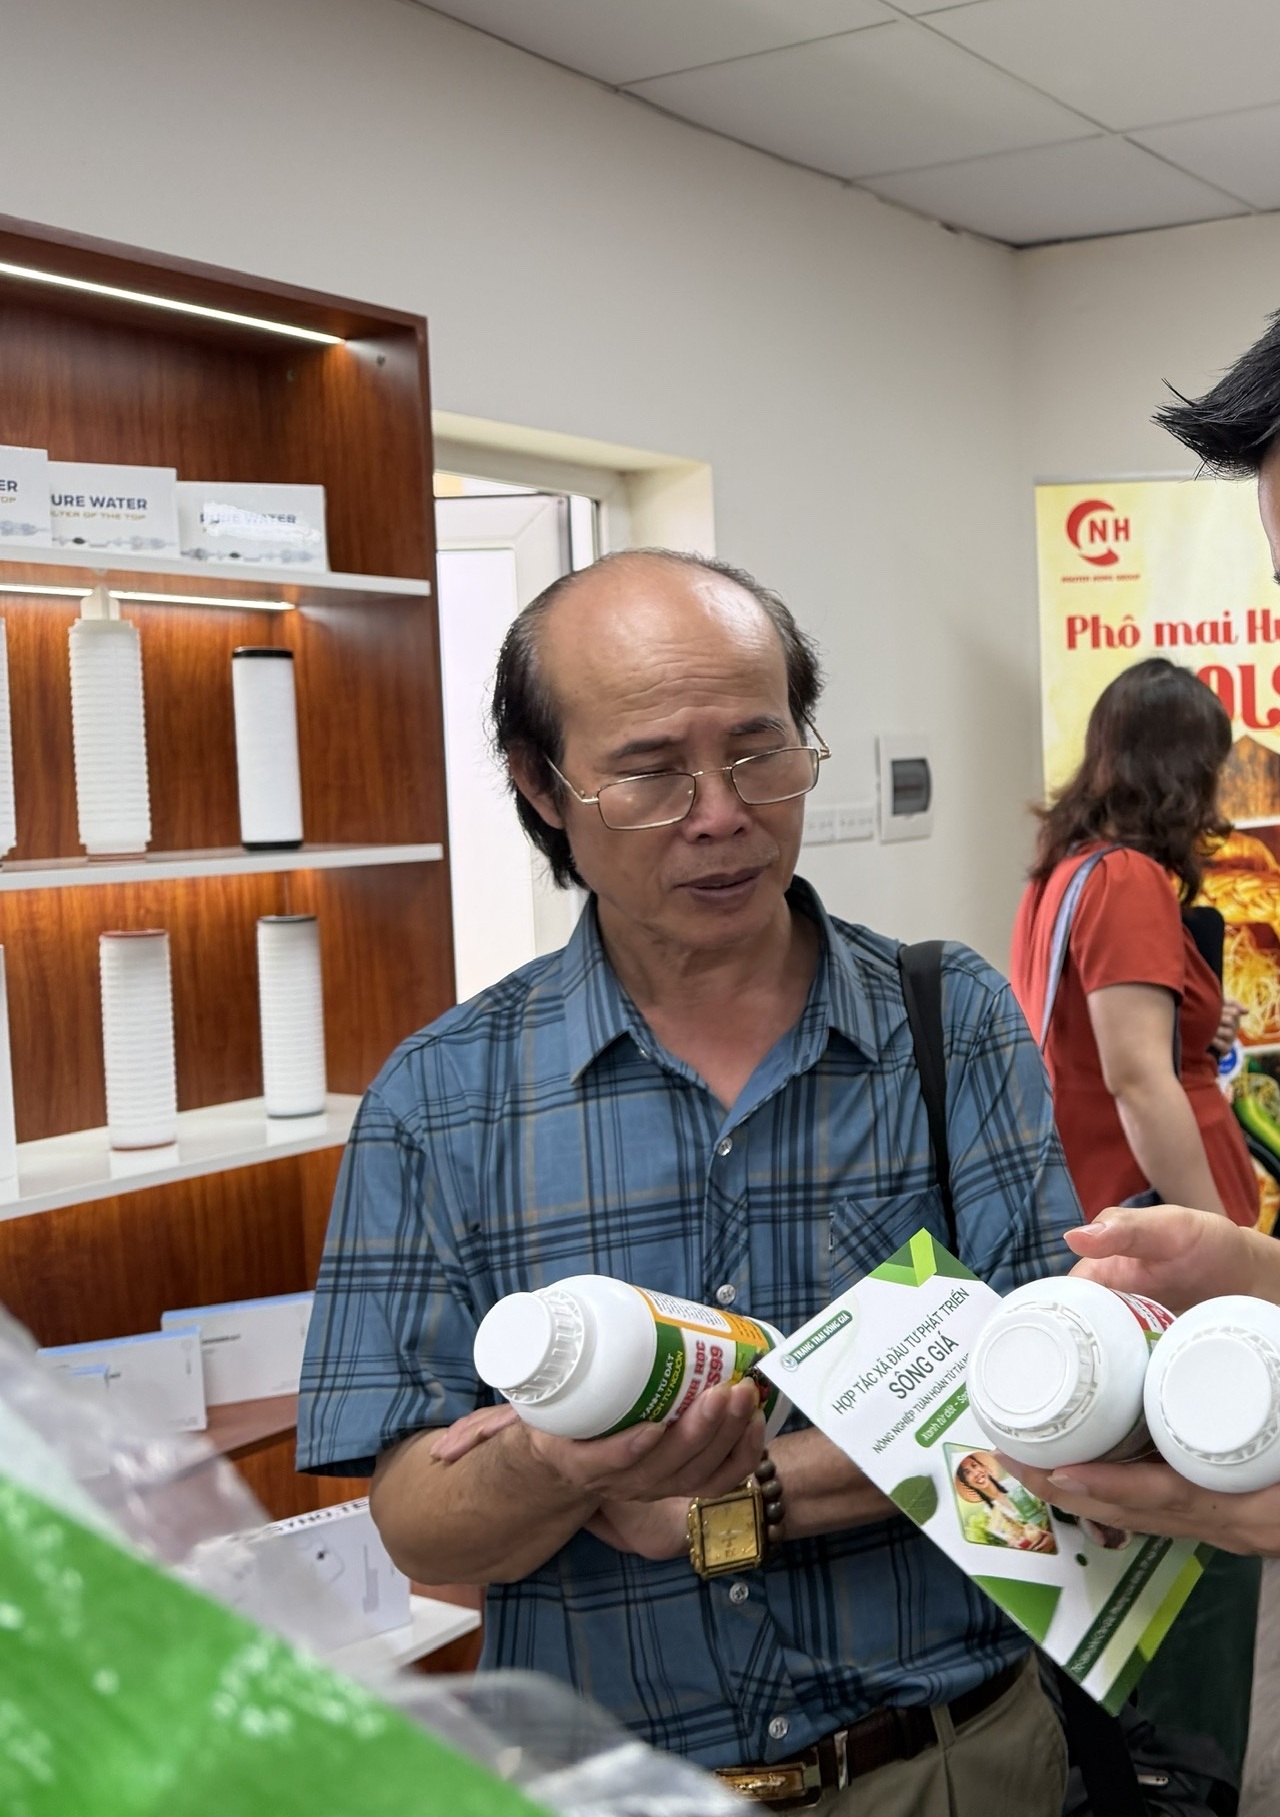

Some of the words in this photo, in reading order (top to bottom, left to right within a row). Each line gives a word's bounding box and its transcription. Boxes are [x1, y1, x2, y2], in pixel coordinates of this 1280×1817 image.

[90, 496, 147, 510] WATER
[1066, 614, 1141, 650] Phô
[1154, 609, 1239, 647] mai
[793, 1341, 815, 1360] TRANG
[823, 1320, 841, 1336] SÔNG
[837, 1312, 850, 1324] GIÁ
[831, 1389, 857, 1415] HỢP
[853, 1373, 879, 1394] TÁC
[873, 1357, 893, 1379] XÃ
[885, 1343, 910, 1366] ĐẦU
[903, 1331, 922, 1348] TƯ
[916, 1313, 944, 1338] PHÁT
[938, 1287, 970, 1317] TRIỂN
[888, 1356, 934, 1400] SÔNG
[927, 1330, 960, 1362] GIÁ
[872, 1432, 894, 1454] NÔNG
[891, 1409, 916, 1435] NGHIỆP
